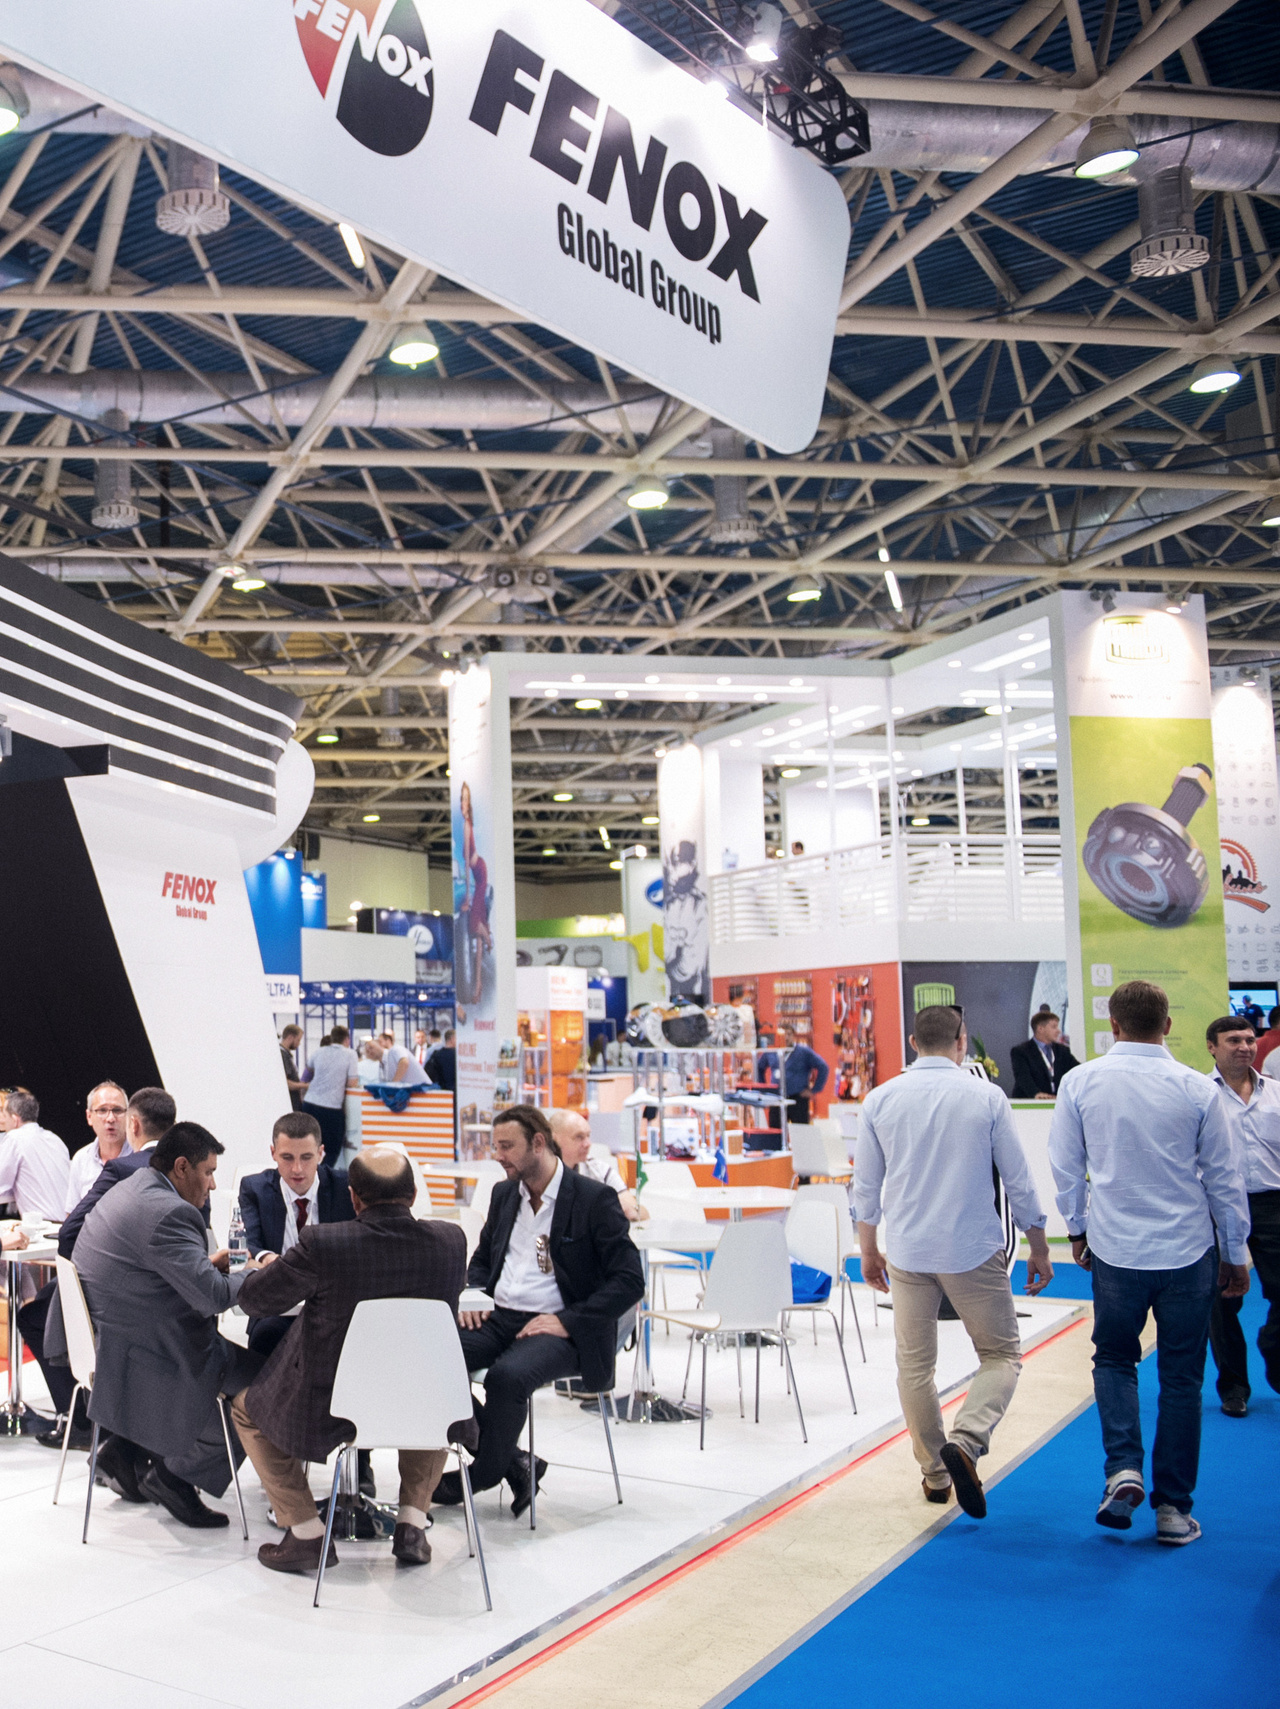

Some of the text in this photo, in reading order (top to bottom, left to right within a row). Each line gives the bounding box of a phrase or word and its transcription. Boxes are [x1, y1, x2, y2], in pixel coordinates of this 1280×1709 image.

[293, 0, 433, 98] FENOX
[468, 28, 769, 305] FENOX
[557, 202, 722, 346] Global Group
[161, 871, 218, 905] FENOX
[266, 982, 293, 997] LTRA
